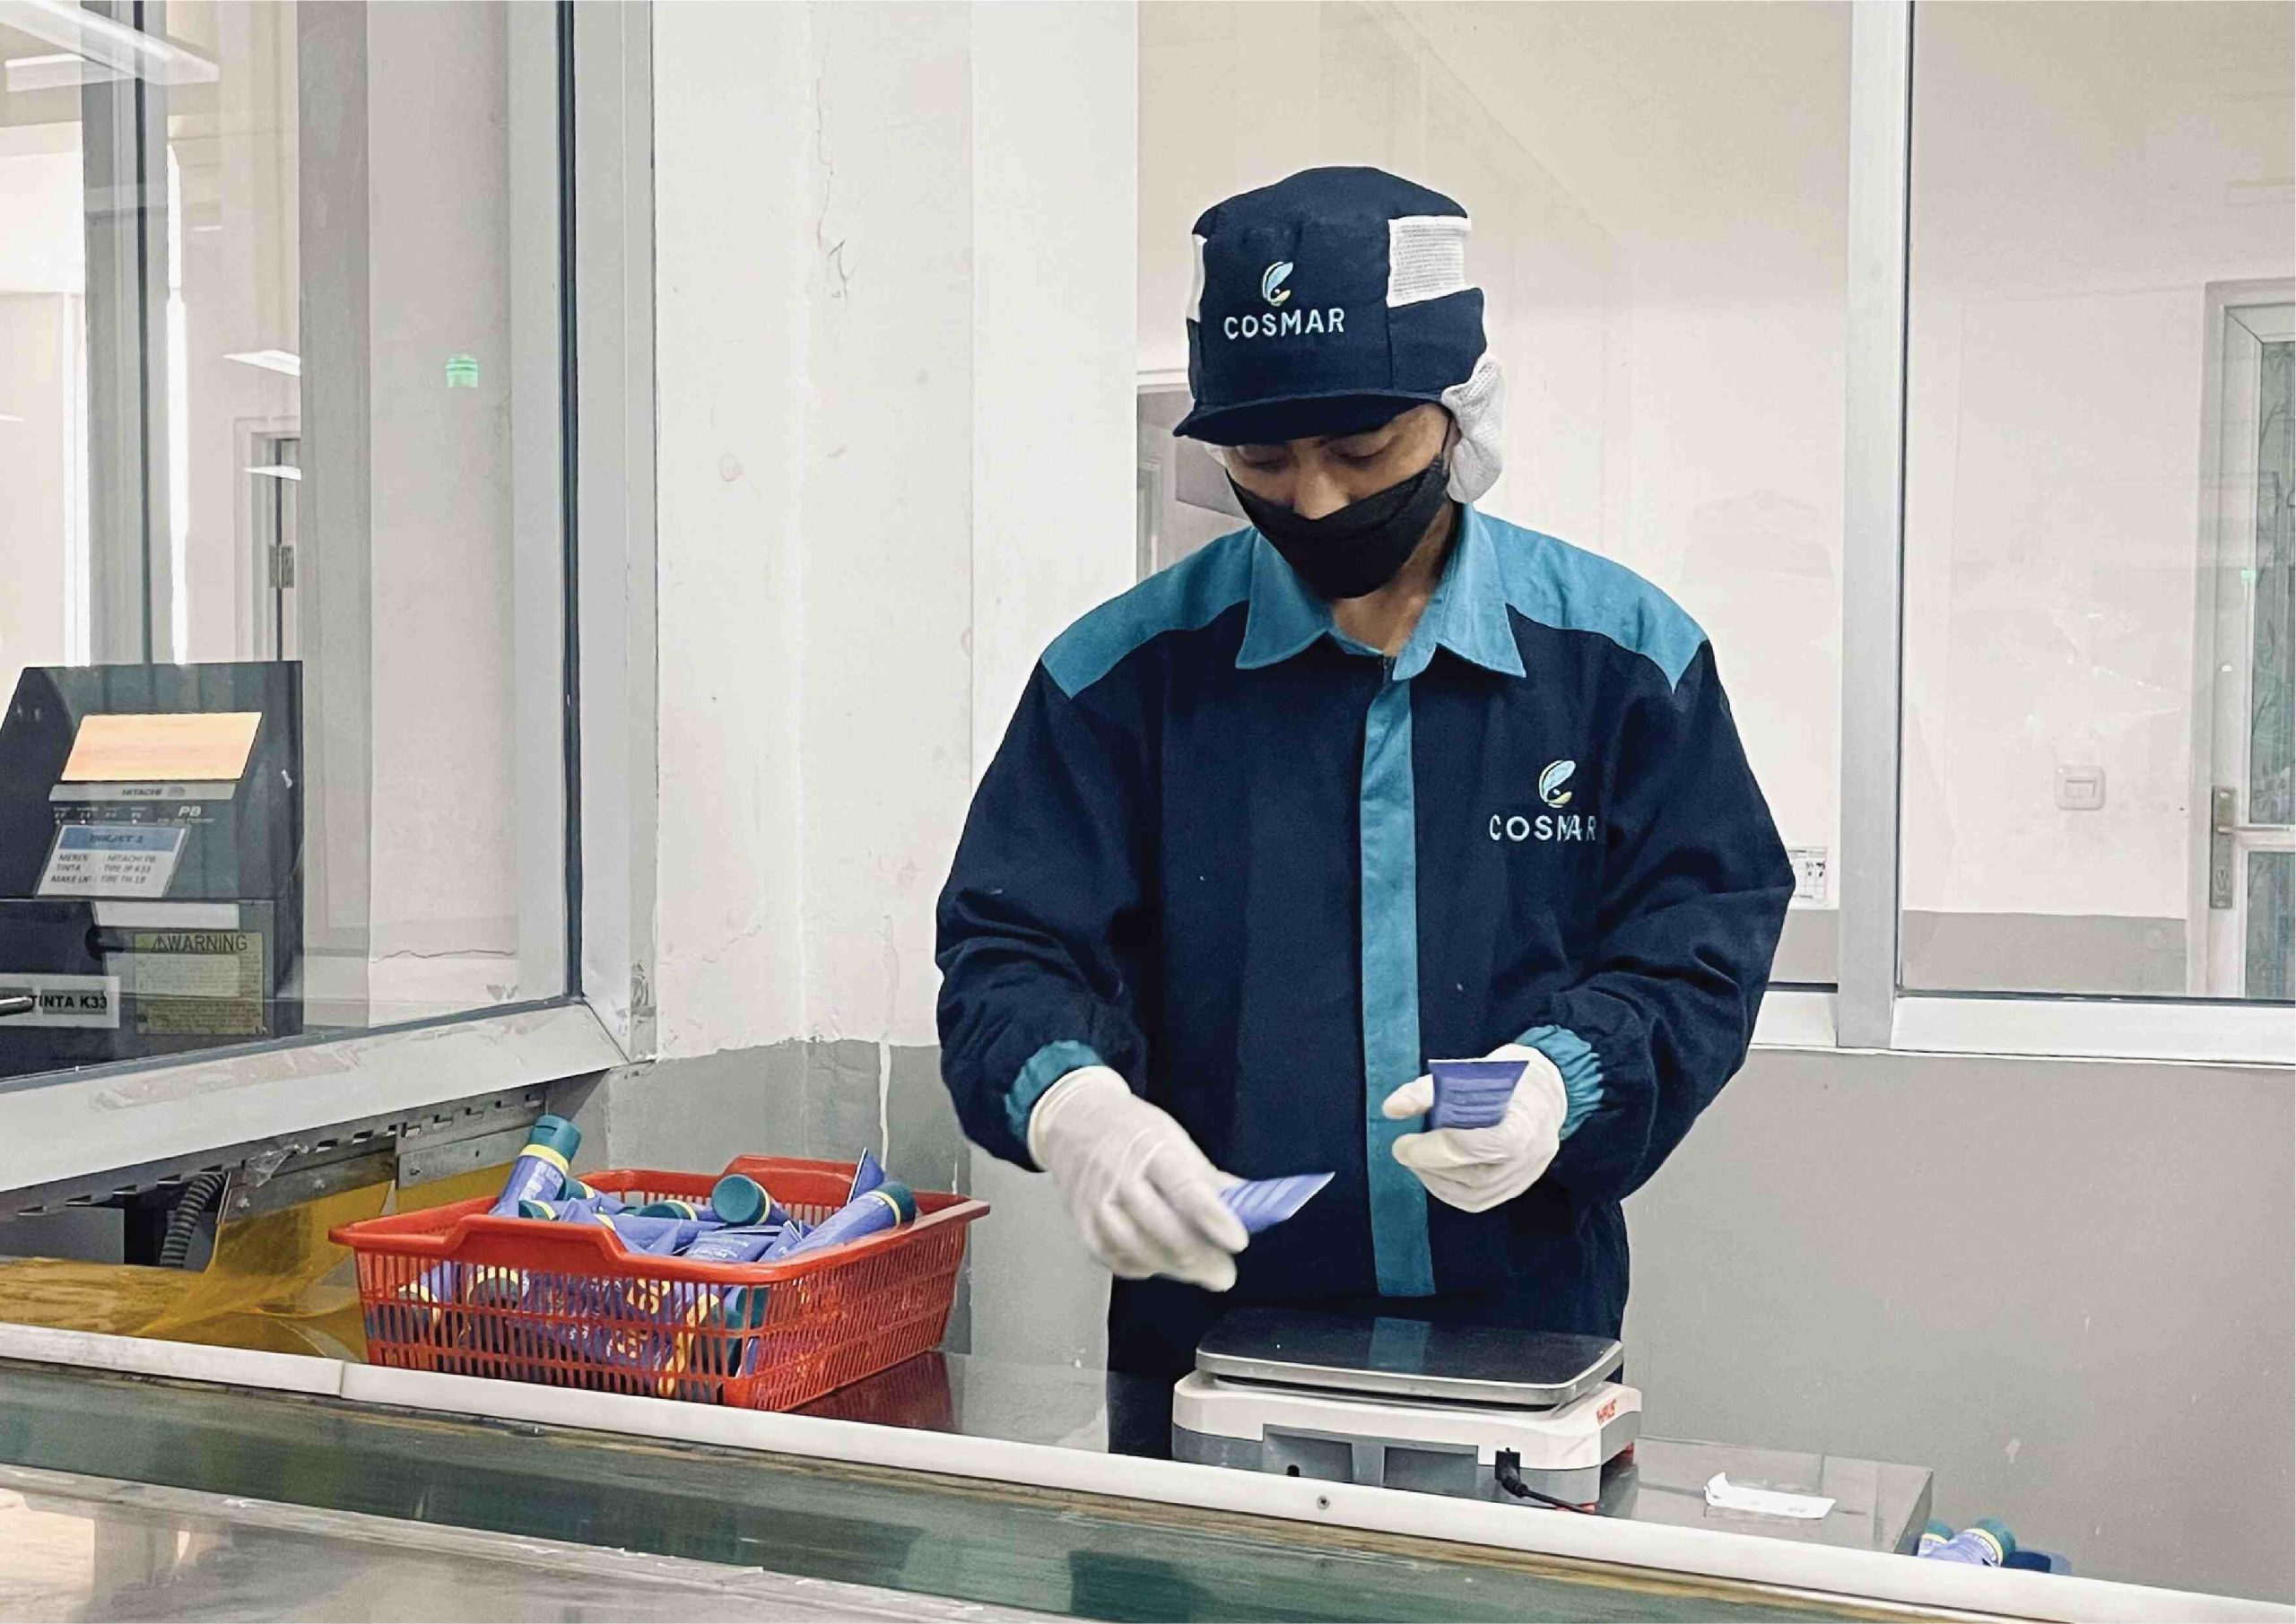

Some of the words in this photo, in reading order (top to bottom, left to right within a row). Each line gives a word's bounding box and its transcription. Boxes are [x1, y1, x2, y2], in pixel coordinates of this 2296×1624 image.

[1223, 308, 1345, 340] COSMAR
[122, 787, 162, 796] HITACHI
[178, 805, 202, 817] PB
[1489, 814, 1597, 842] COSMAR
[167, 934, 248, 951] WARNING
[80, 994, 108, 1009] K33
